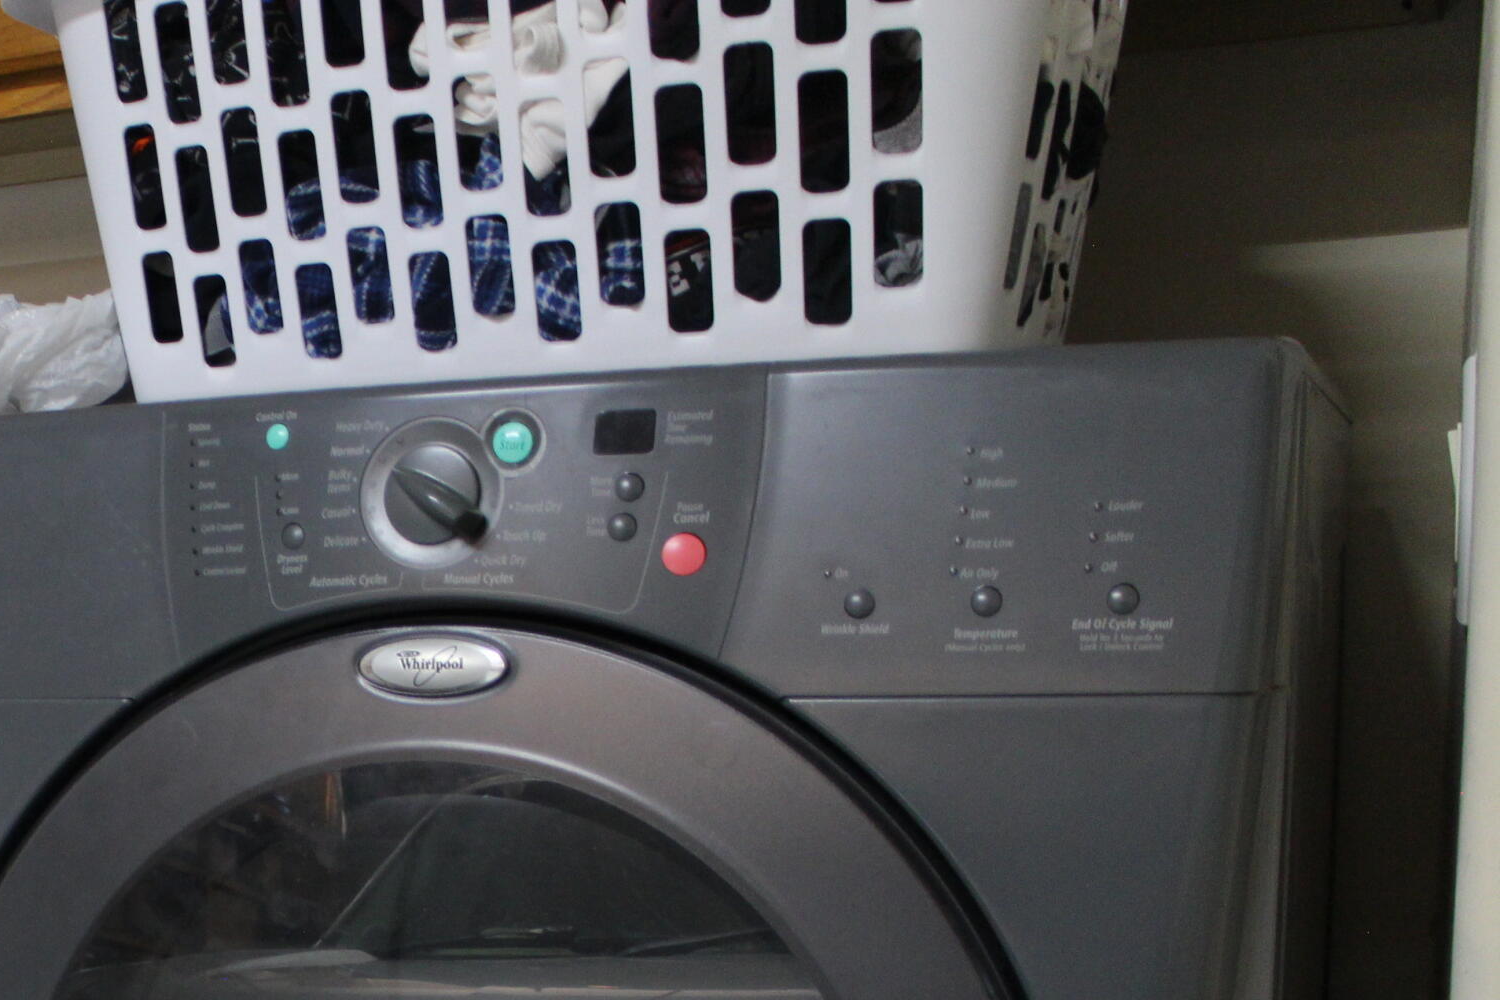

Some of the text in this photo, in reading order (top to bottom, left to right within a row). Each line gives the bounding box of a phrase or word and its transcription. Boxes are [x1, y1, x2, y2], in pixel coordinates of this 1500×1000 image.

[256, 411, 298, 422] Control On
[666, 409, 714, 421] Estimated
[335, 420, 385, 434] Heavy Duty
[499, 439, 526, 452] Start
[664, 434, 714, 446] Remaining
[330, 445, 365, 457] Normal
[327, 469, 353, 482] Bulky
[976, 479, 1018, 489] Medium
[543, 501, 562, 514] Dry
[677, 501, 704, 511] Pause
[1108, 500, 1143, 512] Louder
[321, 507, 352, 519] Casual
[673, 510, 711, 524] Cancel
[970, 508, 991, 520] Low
[323, 535, 360, 548] Delicate
[529, 530, 547, 543] Up
[1105, 531, 1135, 542] Softer
[965, 538, 1015, 549] Extra Low
[277, 554, 307, 566] Dryness
[480, 554, 527, 568] Quick Dry
[1101, 560, 1118, 572] Off
[281, 564, 303, 575] Level
[834, 567, 850, 578] On
[976, 567, 999, 580] Only
[309, 574, 388, 588] Automatic Cycles
[444, 572, 515, 586] Manual Cycles
[820, 623, 890, 635] Wrinkle Shield
[1072, 617, 1174, 632] End Of Cycle Signal
[954, 627, 1019, 641] Temperature
[400, 656, 464, 673] Whirlpool
